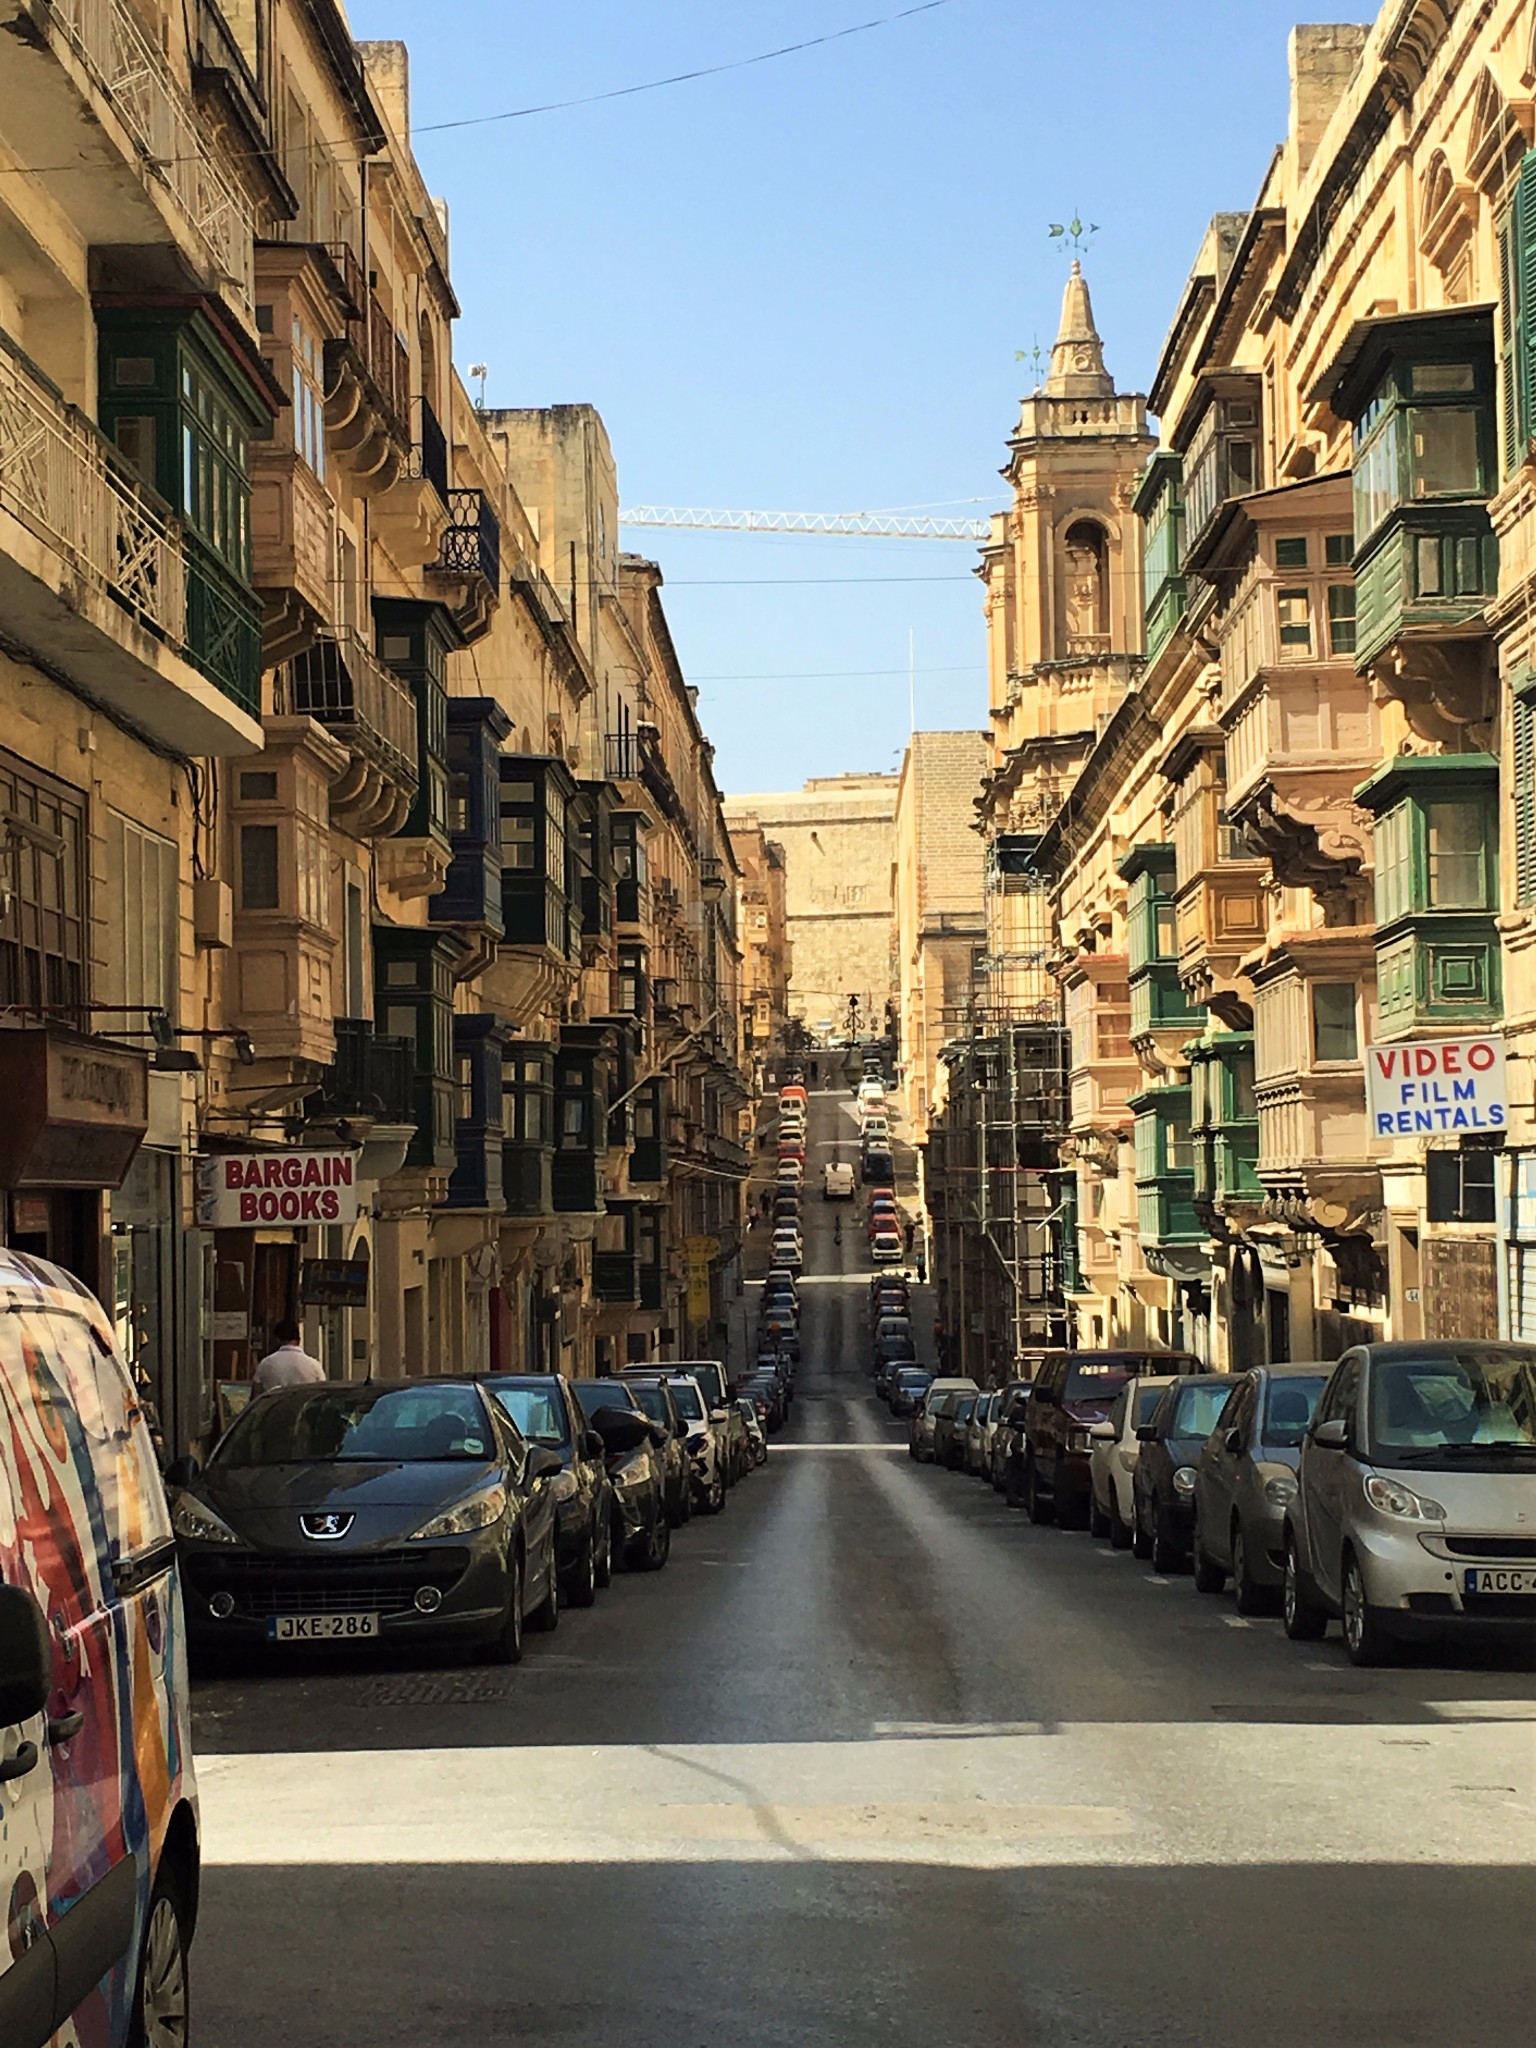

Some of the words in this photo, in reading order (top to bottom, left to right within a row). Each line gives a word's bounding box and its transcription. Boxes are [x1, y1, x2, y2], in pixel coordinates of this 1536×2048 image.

[1375, 1043, 1495, 1079] VIDEO
[1401, 1078, 1476, 1105] FILM
[1377, 1104, 1504, 1135] RENTALS
[225, 1157, 352, 1190] BARGAIN
[240, 1190, 340, 1222] BOOKS
